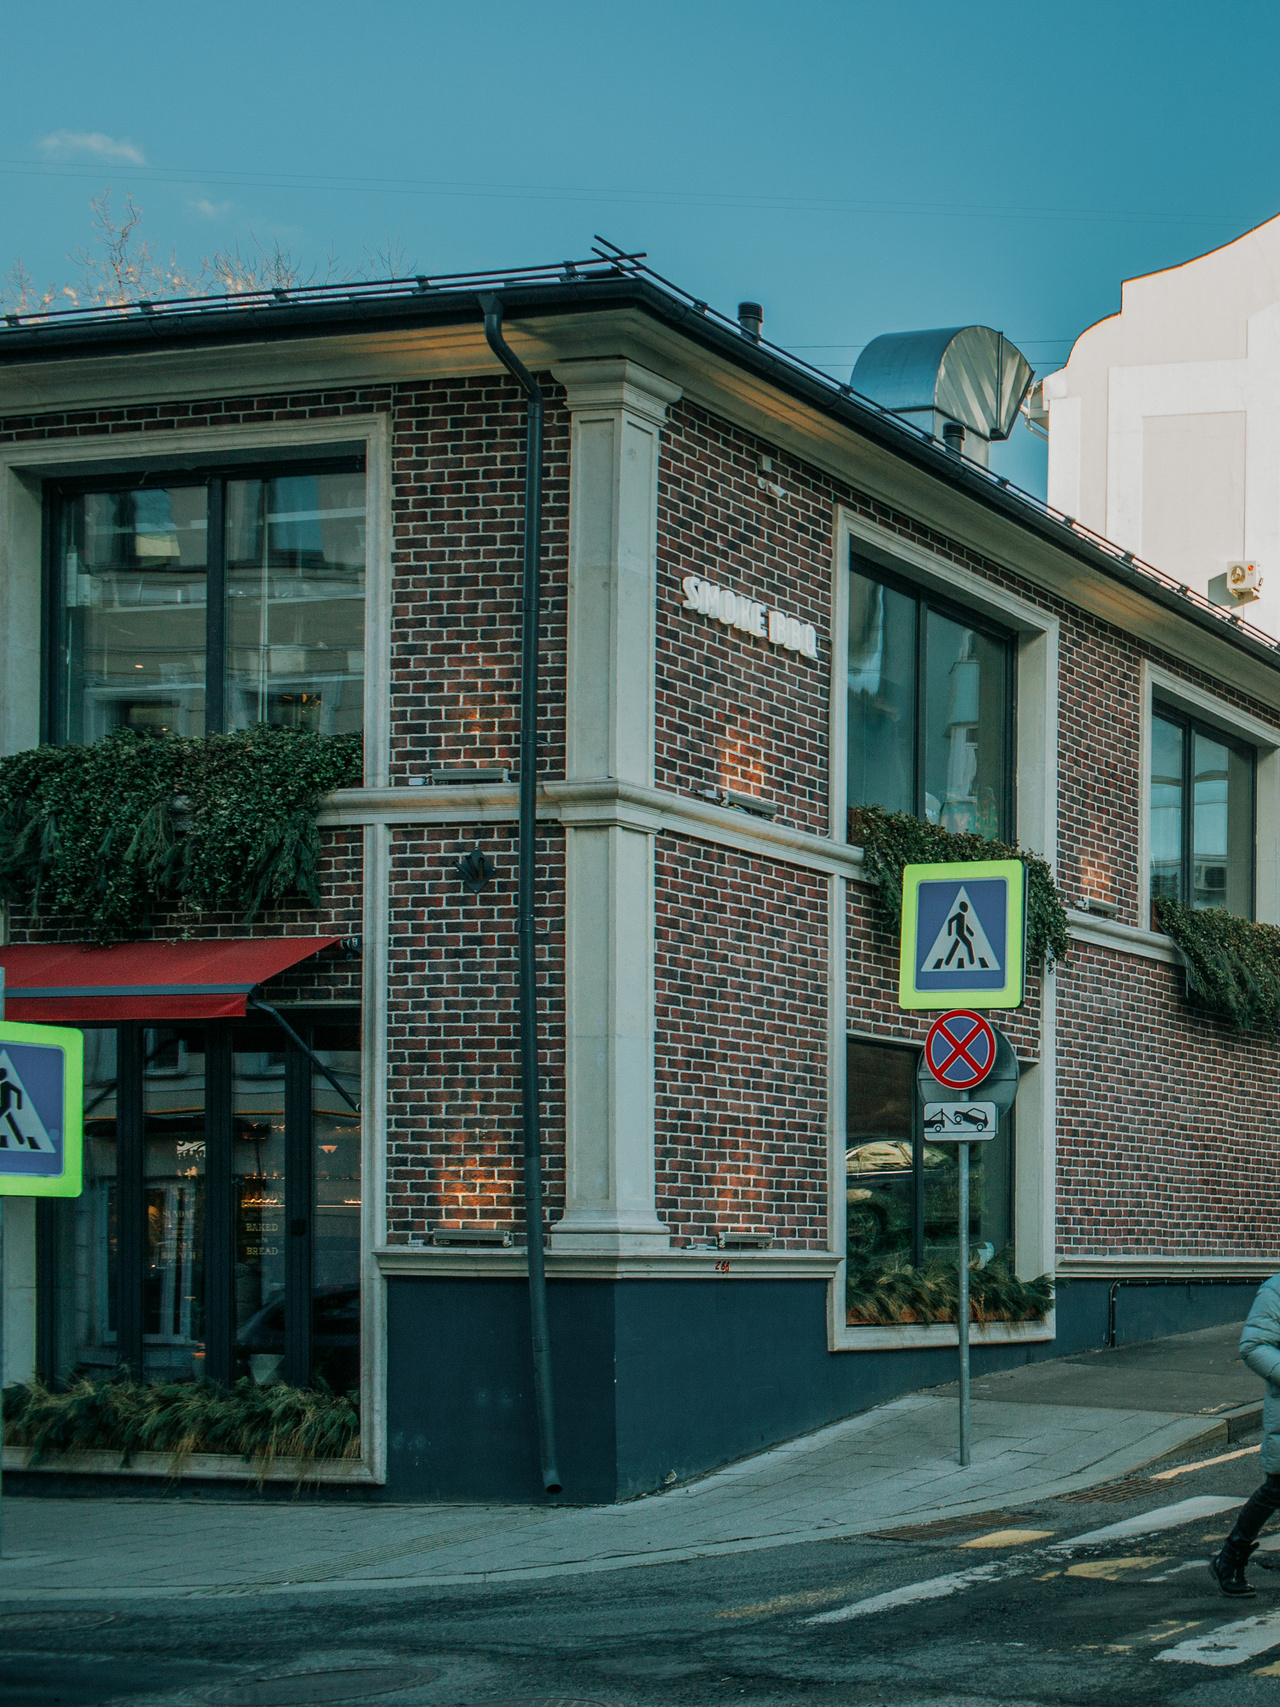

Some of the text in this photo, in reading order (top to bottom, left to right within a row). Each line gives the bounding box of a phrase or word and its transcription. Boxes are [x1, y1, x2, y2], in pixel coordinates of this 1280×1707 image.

[682, 576, 819, 658] SMOKE BBQ
[245, 1223, 279, 1232] BAKED
[246, 1246, 279, 1256] BREAD
